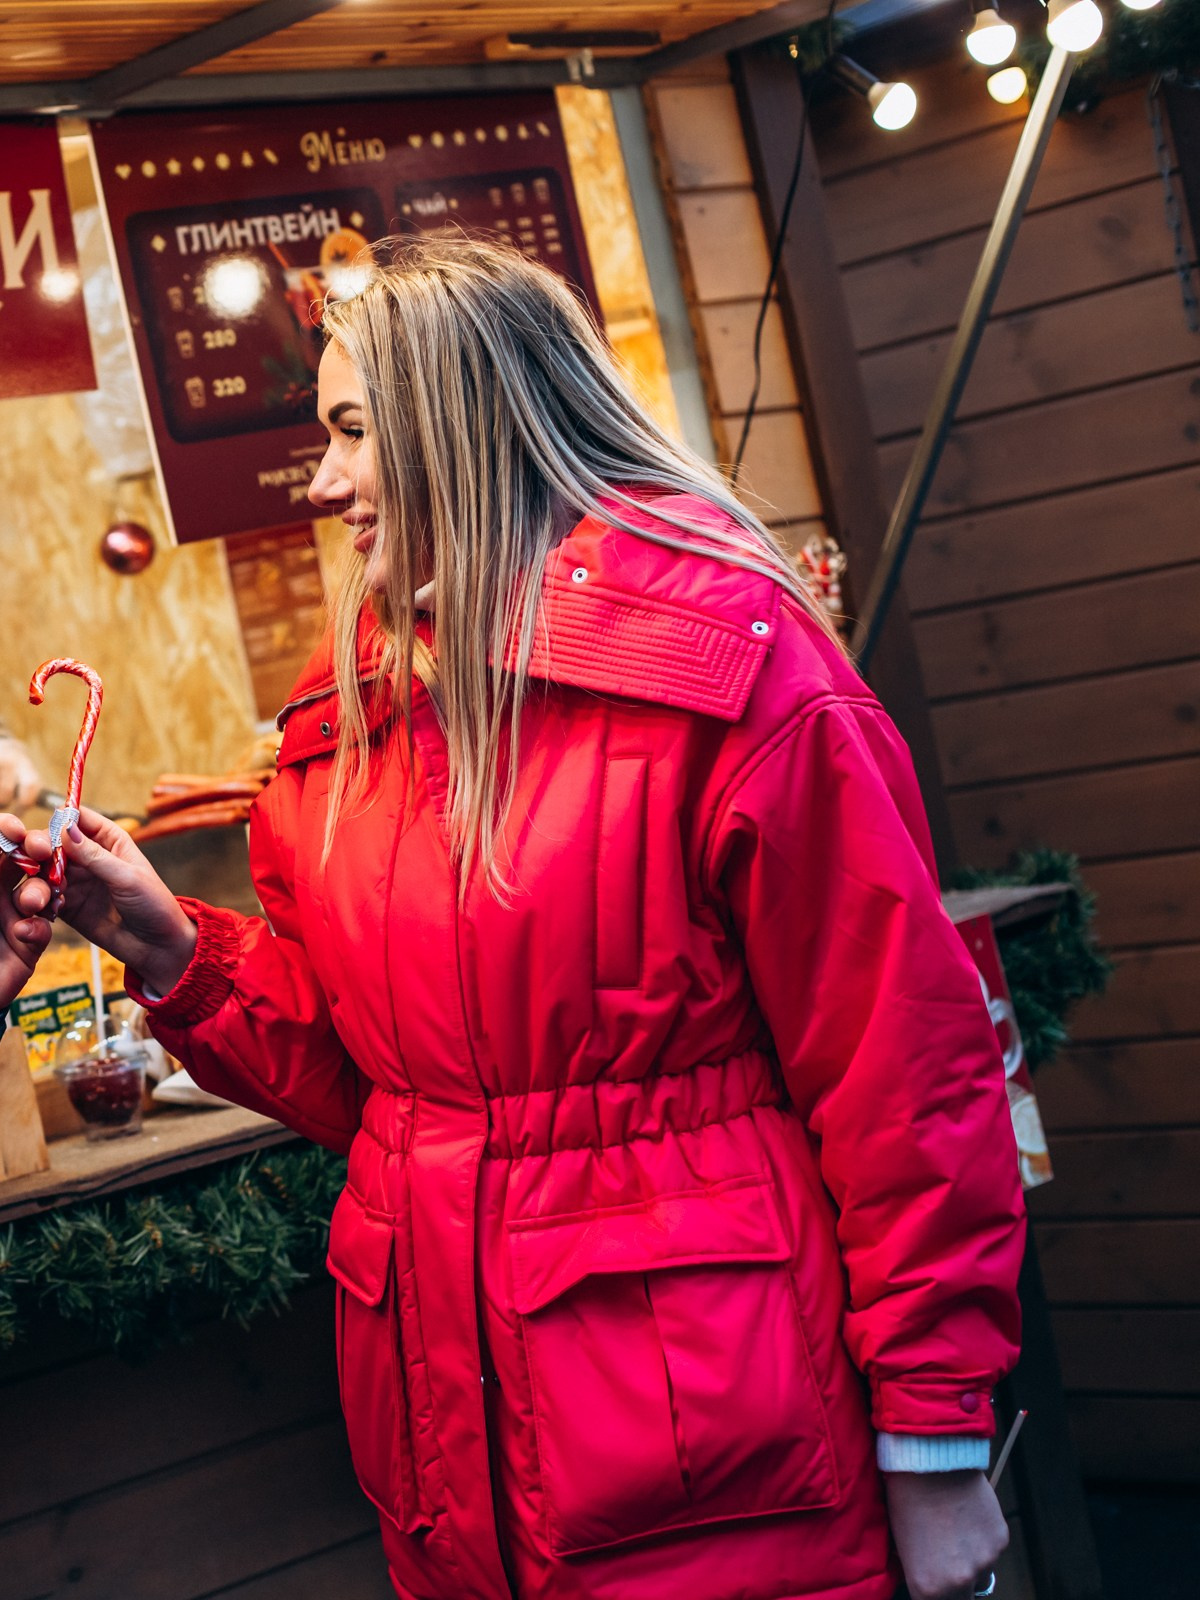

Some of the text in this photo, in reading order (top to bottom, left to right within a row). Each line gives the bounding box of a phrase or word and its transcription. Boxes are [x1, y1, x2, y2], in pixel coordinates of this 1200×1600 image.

[175, 203, 341, 255] ГЛИНТВЕЙН
[202, 328, 237, 349] 280
[212, 376, 246, 397] 320
